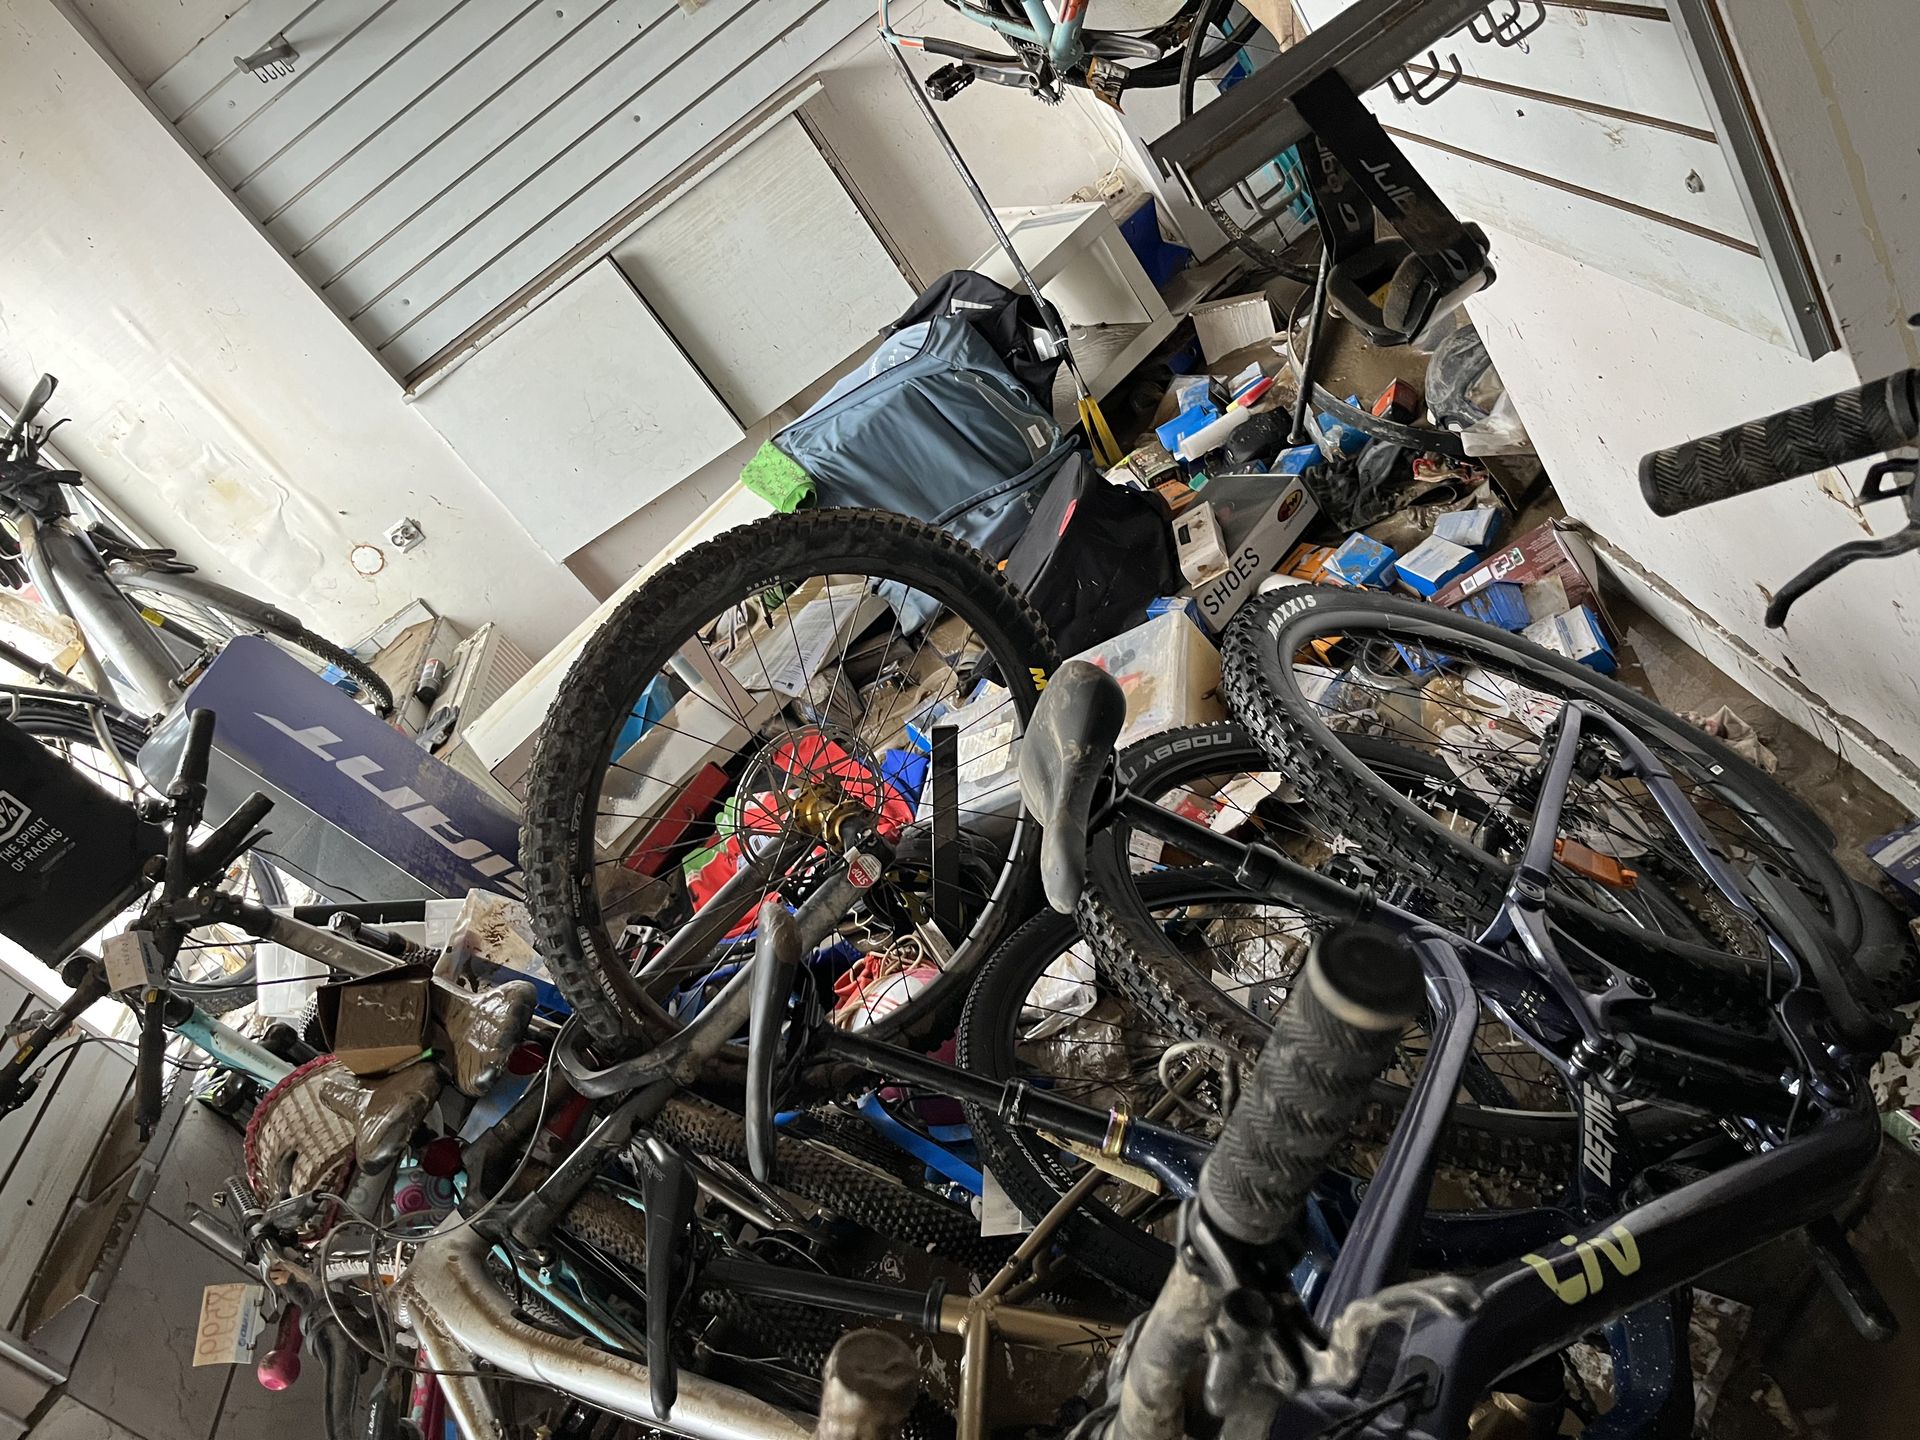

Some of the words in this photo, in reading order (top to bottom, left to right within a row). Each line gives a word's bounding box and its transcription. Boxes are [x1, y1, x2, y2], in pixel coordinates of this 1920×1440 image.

[1220, 212, 1245, 240] SWISS
[1203, 547, 1260, 616] SHOES
[1266, 594, 1317, 643] MAXXIS
[1143, 732, 1232, 770] NOBBY
[0, 842, 22, 862] THE
[15, 817, 49, 848] SPIRIT
[11, 856, 28, 872] OF
[23, 827, 63, 861] RACING
[850, 867, 869, 886] STOP
[1582, 1080, 1619, 1188] DEFINE
